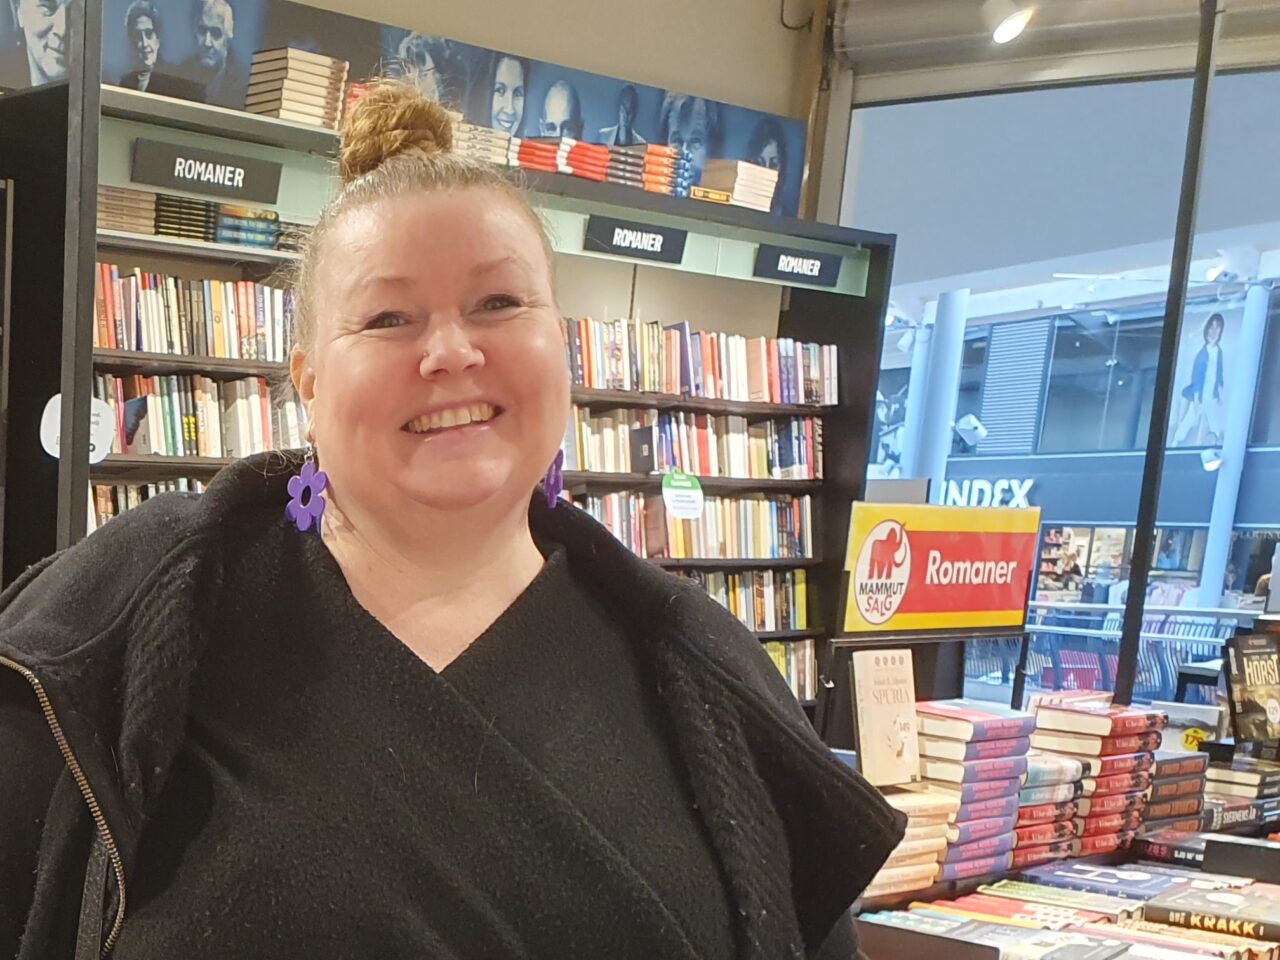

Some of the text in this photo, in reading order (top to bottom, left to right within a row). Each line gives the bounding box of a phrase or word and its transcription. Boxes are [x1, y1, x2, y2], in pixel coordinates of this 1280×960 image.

[174, 157, 245, 188] ROMANER
[612, 227, 664, 252] ROMANER
[777, 254, 821, 276] ROMANER
[939, 479, 1034, 507] INDEX
[925, 550, 1018, 585] Romaner
[858, 582, 905, 596] MAMMUT
[865, 595, 893, 616] SALG
[1243, 654, 1280, 686] HORST
[872, 687, 910, 706] SPURIA
[1190, 913, 1257, 936] KRAKK
